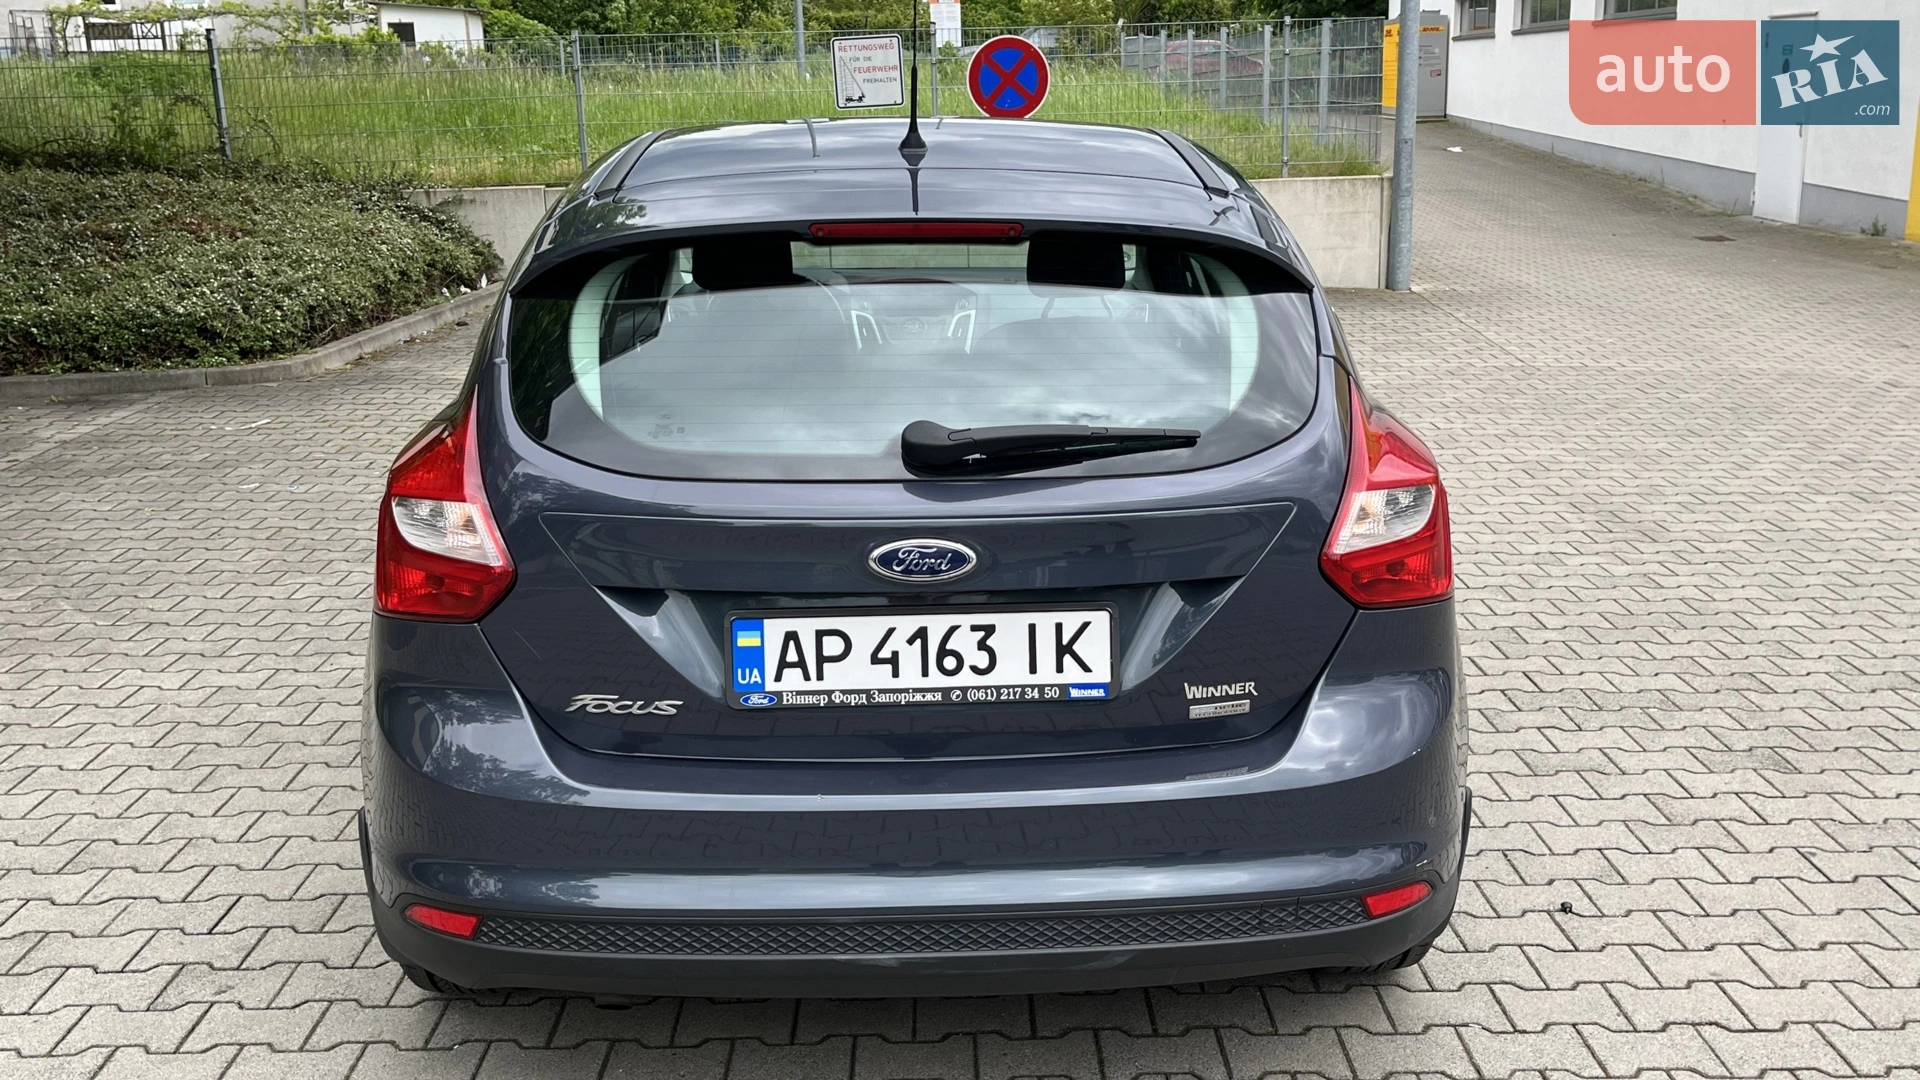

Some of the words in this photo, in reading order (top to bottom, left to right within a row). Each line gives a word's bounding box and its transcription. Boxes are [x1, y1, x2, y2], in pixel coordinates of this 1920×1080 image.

[838, 43, 894, 52] RETTUNGSWEG
[853, 65, 899, 74] FEUERWEHR
[863, 76, 897, 84] FREIHALTEN
[892, 547, 952, 572] Ford
[773, 628, 853, 682] AP
[870, 624, 997, 679] 4163
[1027, 621, 1093, 675] IK
[737, 668, 762, 684] UA
[781, 691, 829, 707] Віннер
[831, 690, 868, 706] Форд
[870, 688, 943, 705] Запоріжжя
[966, 687, 997, 702] (061)
[1000, 687, 1021, 700] 217
[1024, 686, 1040, 699] 34
[1044, 686, 1060, 698] 50
[1068, 686, 1106, 698] WINNER
[1184, 681, 1259, 700] WINNER
[747, 695, 770, 705] Ford
